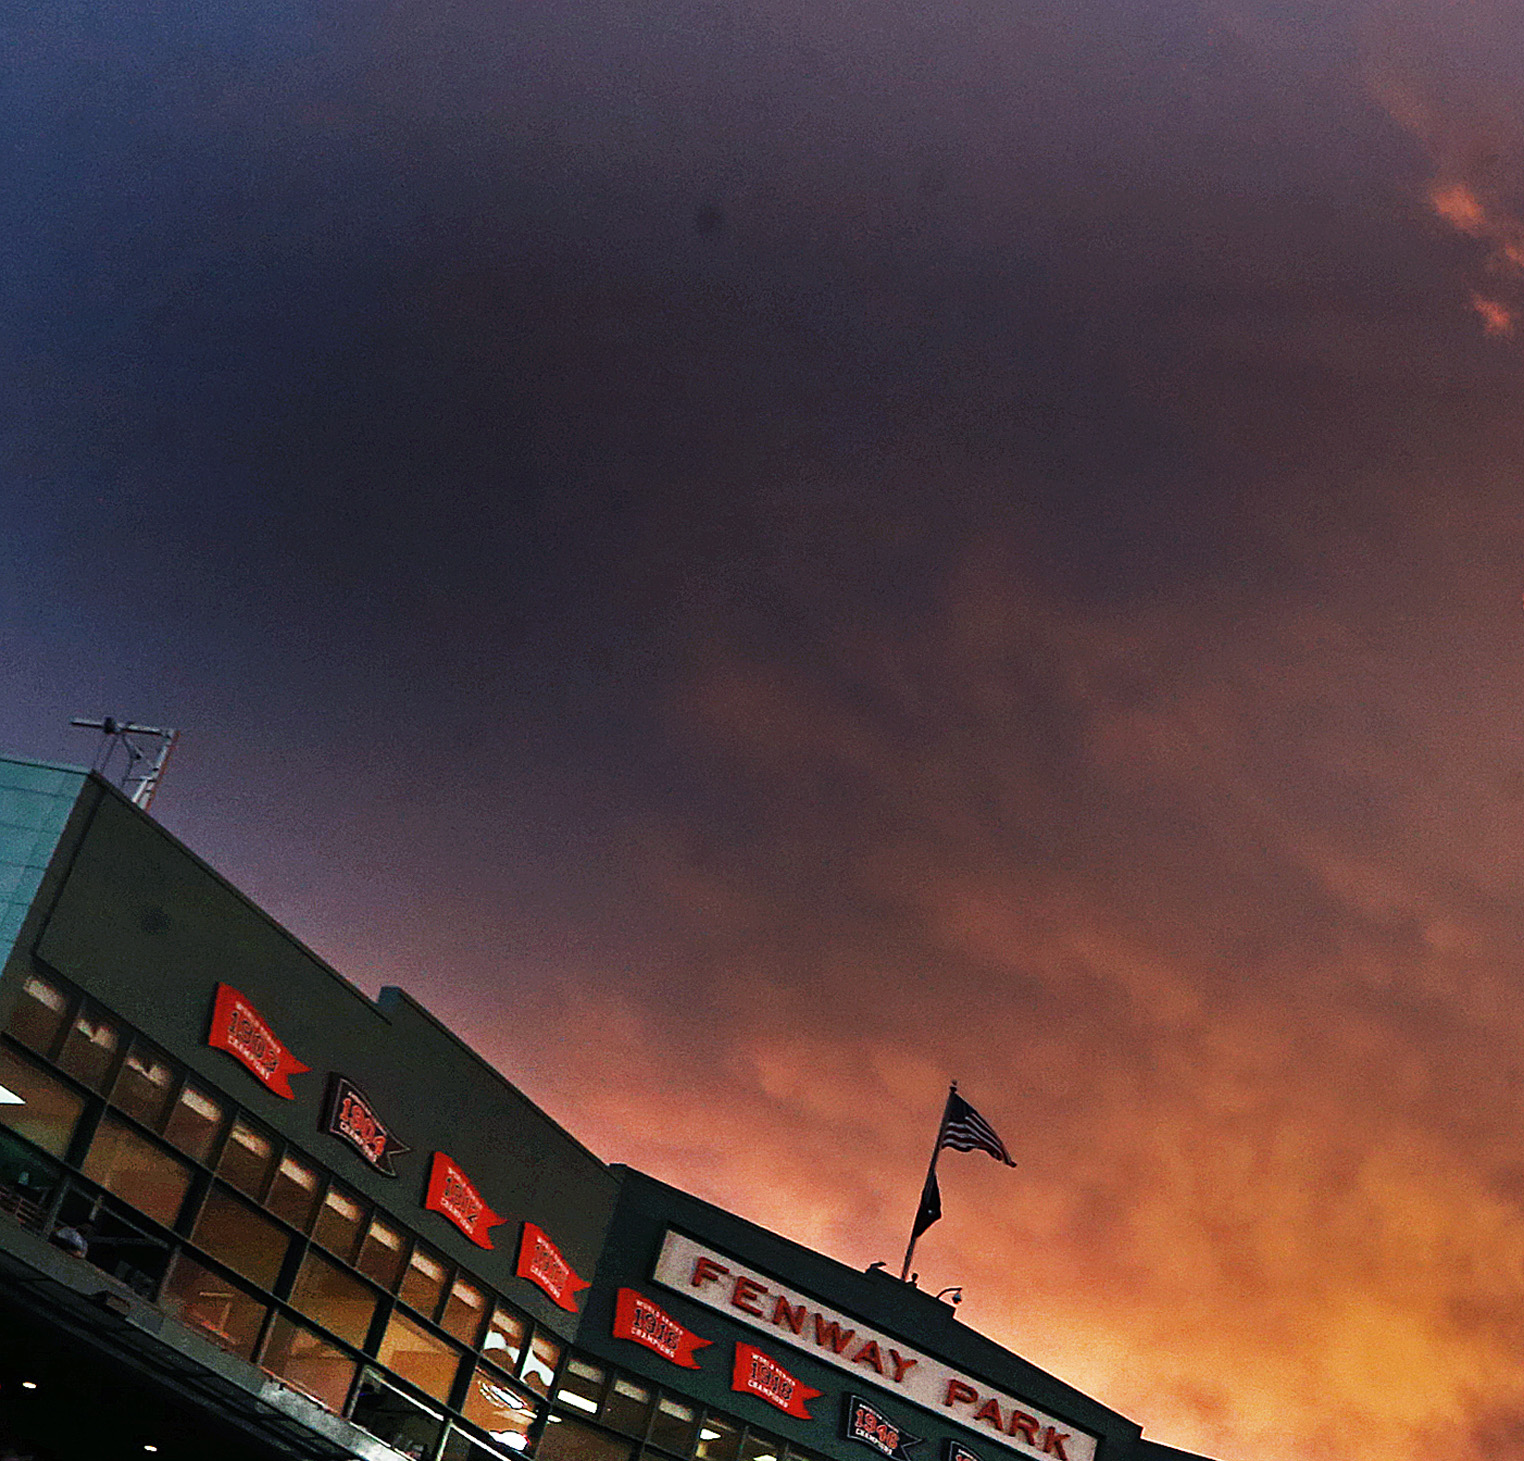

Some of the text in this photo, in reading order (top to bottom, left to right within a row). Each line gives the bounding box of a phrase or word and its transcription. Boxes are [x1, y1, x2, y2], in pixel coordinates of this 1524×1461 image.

[690, 1256, 1071, 1461] FENWAY PARK
[748, 1379, 789, 1409] CHAMPIONS
[855, 1409, 900, 1450] 1946
